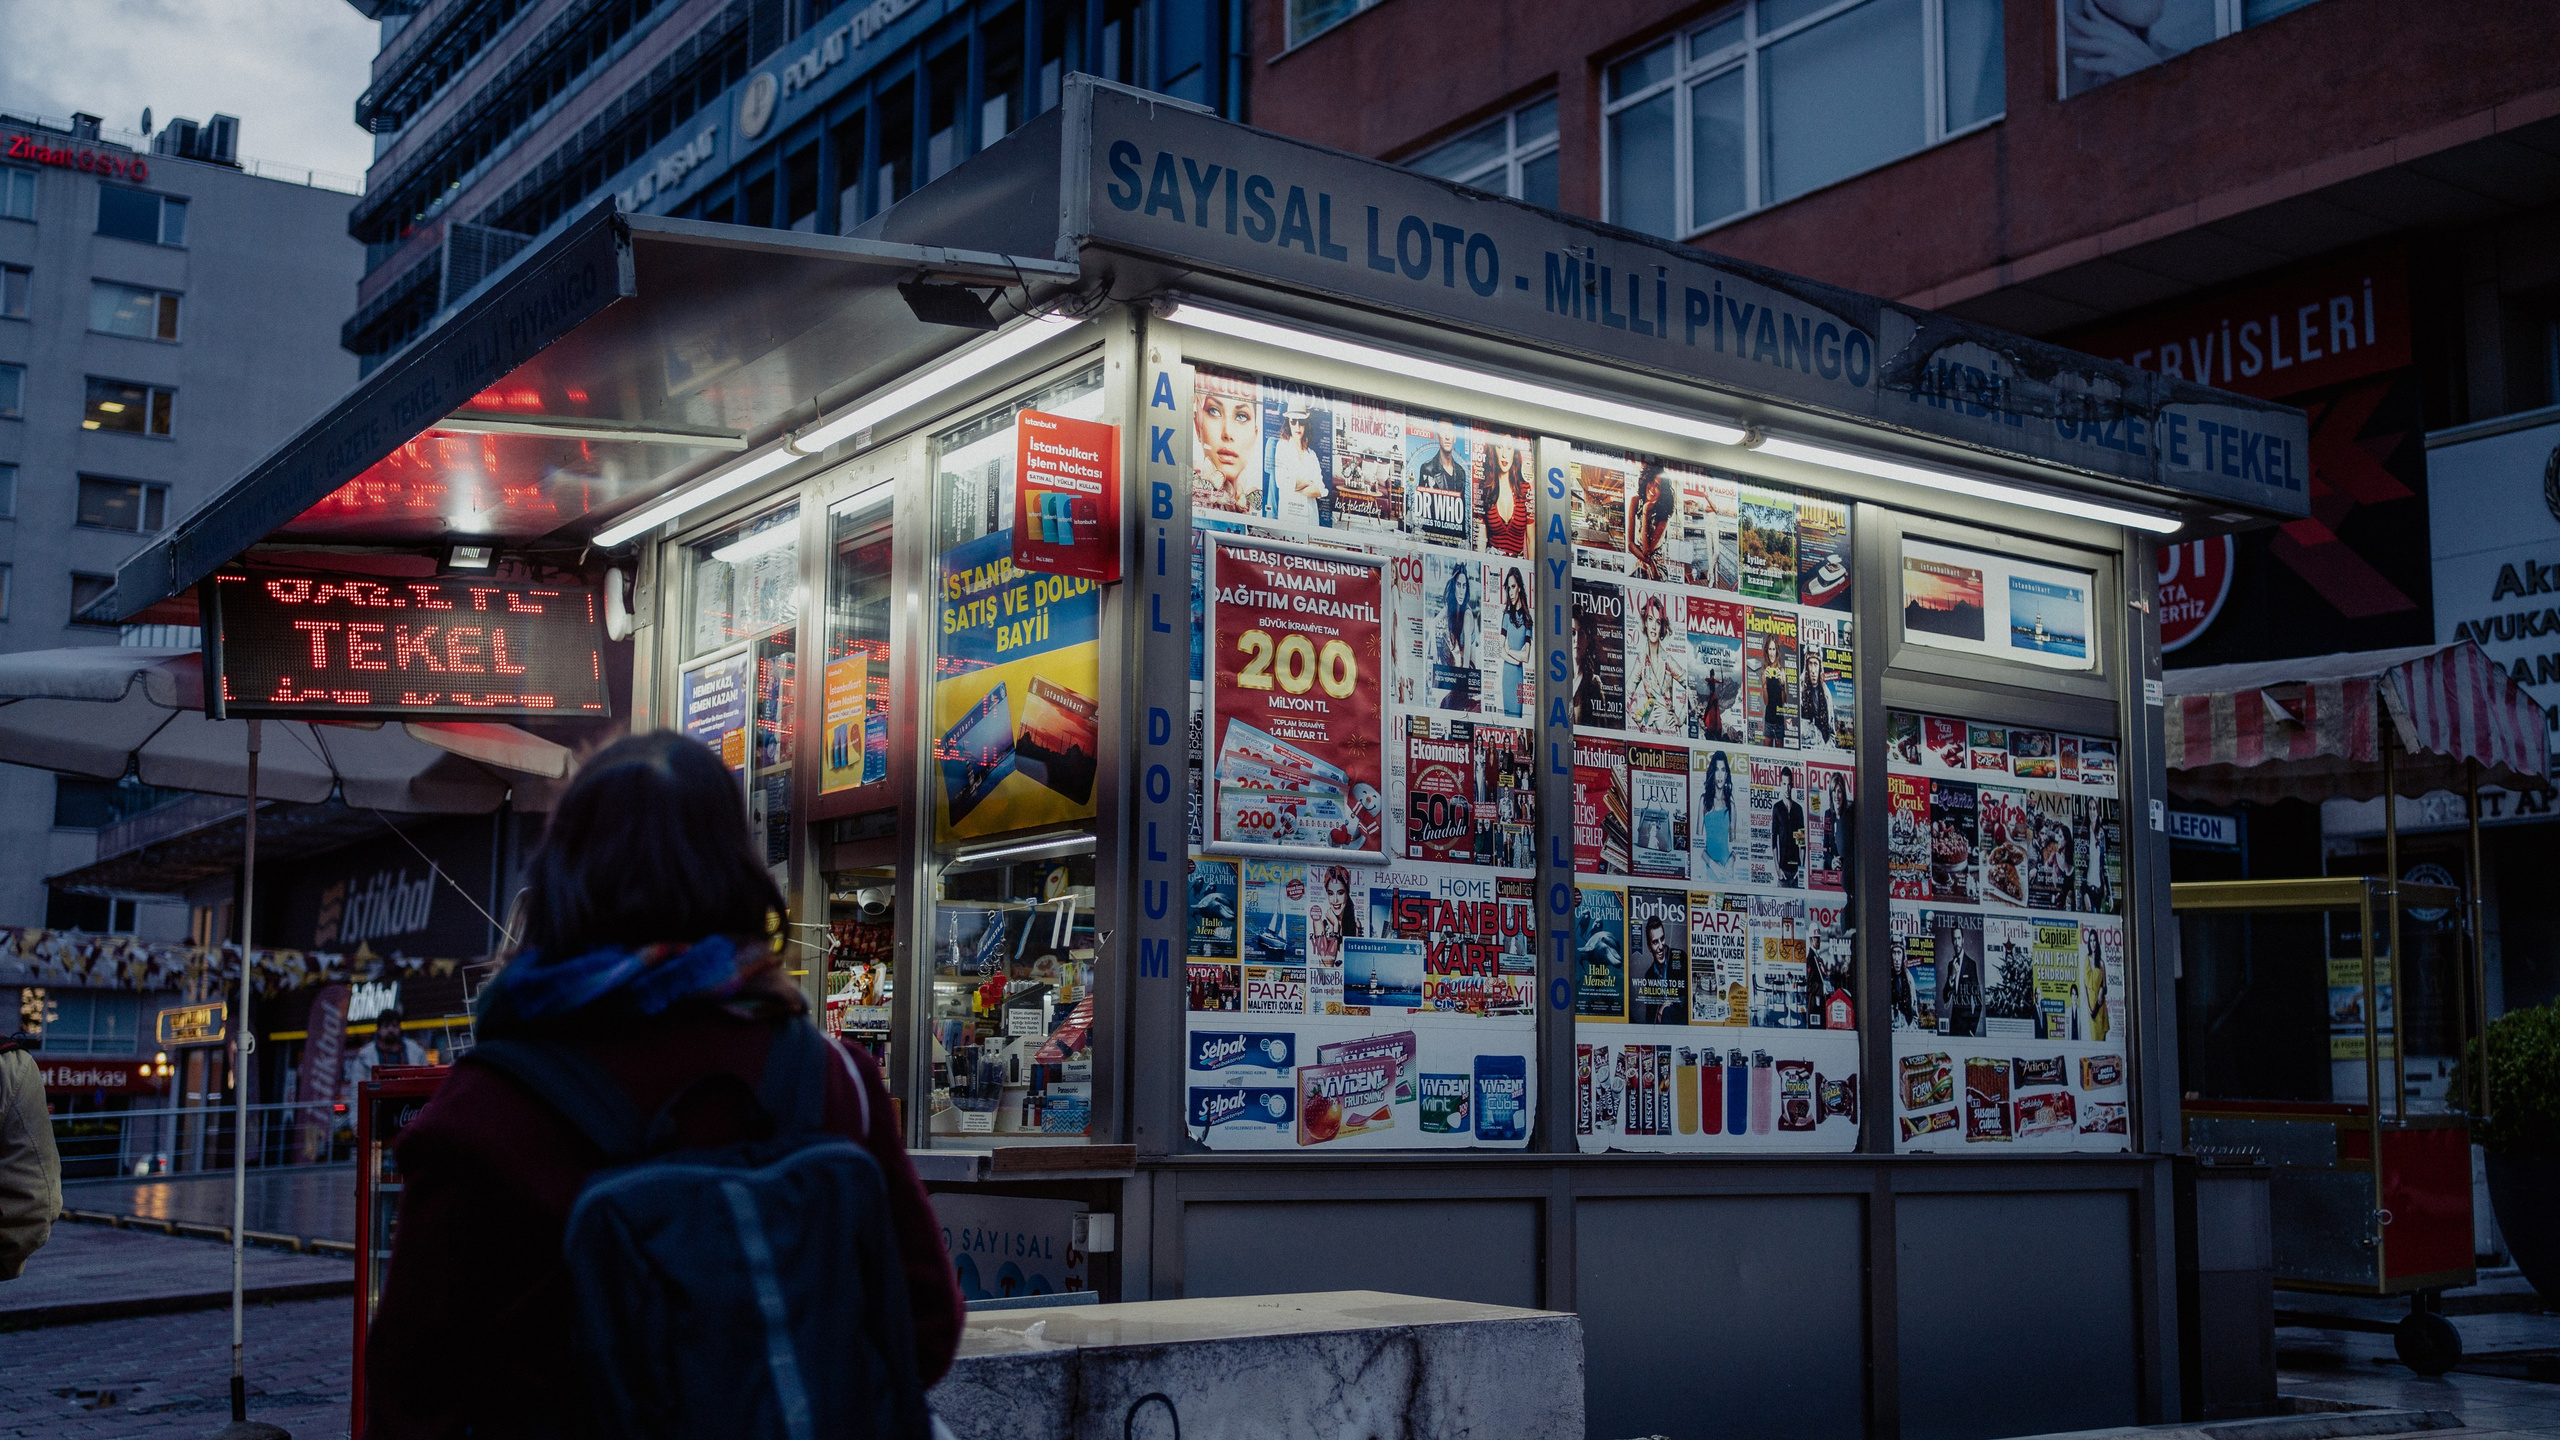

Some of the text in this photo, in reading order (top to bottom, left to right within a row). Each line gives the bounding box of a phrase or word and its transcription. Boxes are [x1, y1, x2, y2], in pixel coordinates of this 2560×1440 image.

[8, 136, 73, 168] Ziraat
[1107, 140, 1348, 263] SAYISAL
[1366, 204, 1501, 297] LOTO
[1545, 246, 1668, 340] MİLLİ
[1685, 280, 1871, 388] PİYANGO
[2198, 417, 2302, 493] TEKEL
[2112, 277, 2378, 387] ERVİSLERİ
[391, 384, 442, 437] TEKEL
[509, 259, 599, 352] PİYANGO
[1410, 427, 1431, 438] London
[1029, 436, 1099, 462] İstanbulkart
[1027, 452, 1102, 479] İşlem Noktası
[1056, 478, 1073, 487] YÜKLE
[1078, 482, 1099, 492] KULLAN
[1151, 371, 1175, 634] AKBİL
[1415, 490, 1464, 524] DR WHO
[1415, 517, 1463, 532] COMES TO LONDON
[1226, 547, 1281, 568] YILBAŞI
[943, 553, 1036, 603] İSTANB
[1920, 563, 1960, 578] istanbulkart
[1263, 570, 1336, 596] TAMAMI
[1401, 583, 1423, 600] easy
[1483, 565, 1535, 609] ELE
[2012, 580, 2051, 594] istanbulkart
[943, 573, 1101, 635] SATIŞ VE DOLU
[1293, 595, 1382, 623] GARANTİL
[1571, 591, 1622, 618] TEMPO
[1627, 587, 1686, 625] VOGUE
[996, 606, 1049, 653] BAYİİ
[1259, 617, 1339, 636] BÜYÜK İKRAMİYE TAM
[1546, 466, 1569, 776] SAYISAL
[1687, 613, 1735, 638] MAGMA
[1746, 613, 1797, 637] Hardware
[2453, 608, 2560, 646] AVUKA
[1626, 628, 1640, 646] 50
[1801, 618, 1837, 647] tarih
[294, 619, 526, 675] TEKEL
[1237, 629, 1358, 699] 200
[2494, 652, 2560, 686] AN
[692, 681, 716, 699] HEMEN
[689, 688, 738, 715] HEMEN KAZAN!
[1043, 688, 1084, 714] istanbulkart
[1269, 696, 1330, 713] MİLYON TL
[1607, 701, 1623, 714] 2012
[1269, 727, 1330, 741] 1.4 MİLYAR TL
[1273, 718, 1325, 730] TOPLAM İKRAMİYE
[1410, 738, 1470, 765] Ekonomist
[1628, 746, 1666, 771] Capital
[1750, 762, 1805, 790] Men's Hlth
[1887, 777, 1915, 796] Bilim
[1641, 785, 1678, 804] LUXE
[1750, 789, 1780, 801] FLAT-BELLY
[1750, 799, 1773, 810] FOODS
[1892, 793, 1925, 813] Çocuk
[1409, 790, 1470, 842] 500
[1981, 791, 2027, 825] Sofra
[1236, 809, 1276, 830] 200
[2168, 812, 2222, 840] LEFON
[1413, 818, 1468, 843] Anadolu
[1140, 706, 1171, 979] DOLUM
[1195, 863, 1231, 876] NATIONAL
[1245, 864, 1306, 883] YACHT
[1374, 871, 1429, 887] HARVARD
[1440, 878, 1491, 899] HOME
[1496, 880, 1522, 898] Capital
[340, 860, 438, 945] istikbal
[1582, 894, 1617, 907] NATIONAL
[1630, 895, 1686, 923] Forbes
[1732, 900, 1747, 909] EVLER
[1201, 917, 1223, 927] Hallo
[1391, 888, 1536, 938] İSTANBUL
[1551, 823, 1572, 1011] LOTO
[1691, 910, 1745, 935] PARA
[1749, 918, 1761, 927] Gün
[1935, 915, 1983, 931] THE RAKE
[1348, 942, 1387, 951] istanbulkart
[1692, 933, 1745, 948] MALİYETİ ÇOK AZ
[1909, 938, 1919, 948] 100
[2038, 927, 2071, 948] Capital
[1426, 941, 1505, 978] KART
[1692, 945, 1745, 960] KAZANCI YÜKSEK
[2033, 951, 2079, 968] AYNI FİYAT
[1588, 963, 1610, 976] Hallo
[2036, 967, 2077, 983] SENDROMU
[1247, 982, 1300, 1000] PARA
[1423, 981, 1485, 1002] DOLUM
[1582, 975, 1617, 988] Mensch!
[1632, 978, 1646, 987] WHO
[1647, 979, 1668, 987] WANTS
[1644, 986, 1679, 996] BILLIONAIRE
[1247, 1000, 1303, 1012] MALİYETİ ÇOK AZ
[1199, 1034, 1247, 1061] Selpak
[57, 1066, 127, 1088] Bankası
[1067, 1063, 1087, 1071] Panasonic
[1057, 1085, 1079, 1094] Panasonic
[1198, 1090, 1247, 1118] Selpak
[1486, 1098, 1520, 1111] Cube
[962, 1228, 1053, 1260] SAYISAL
